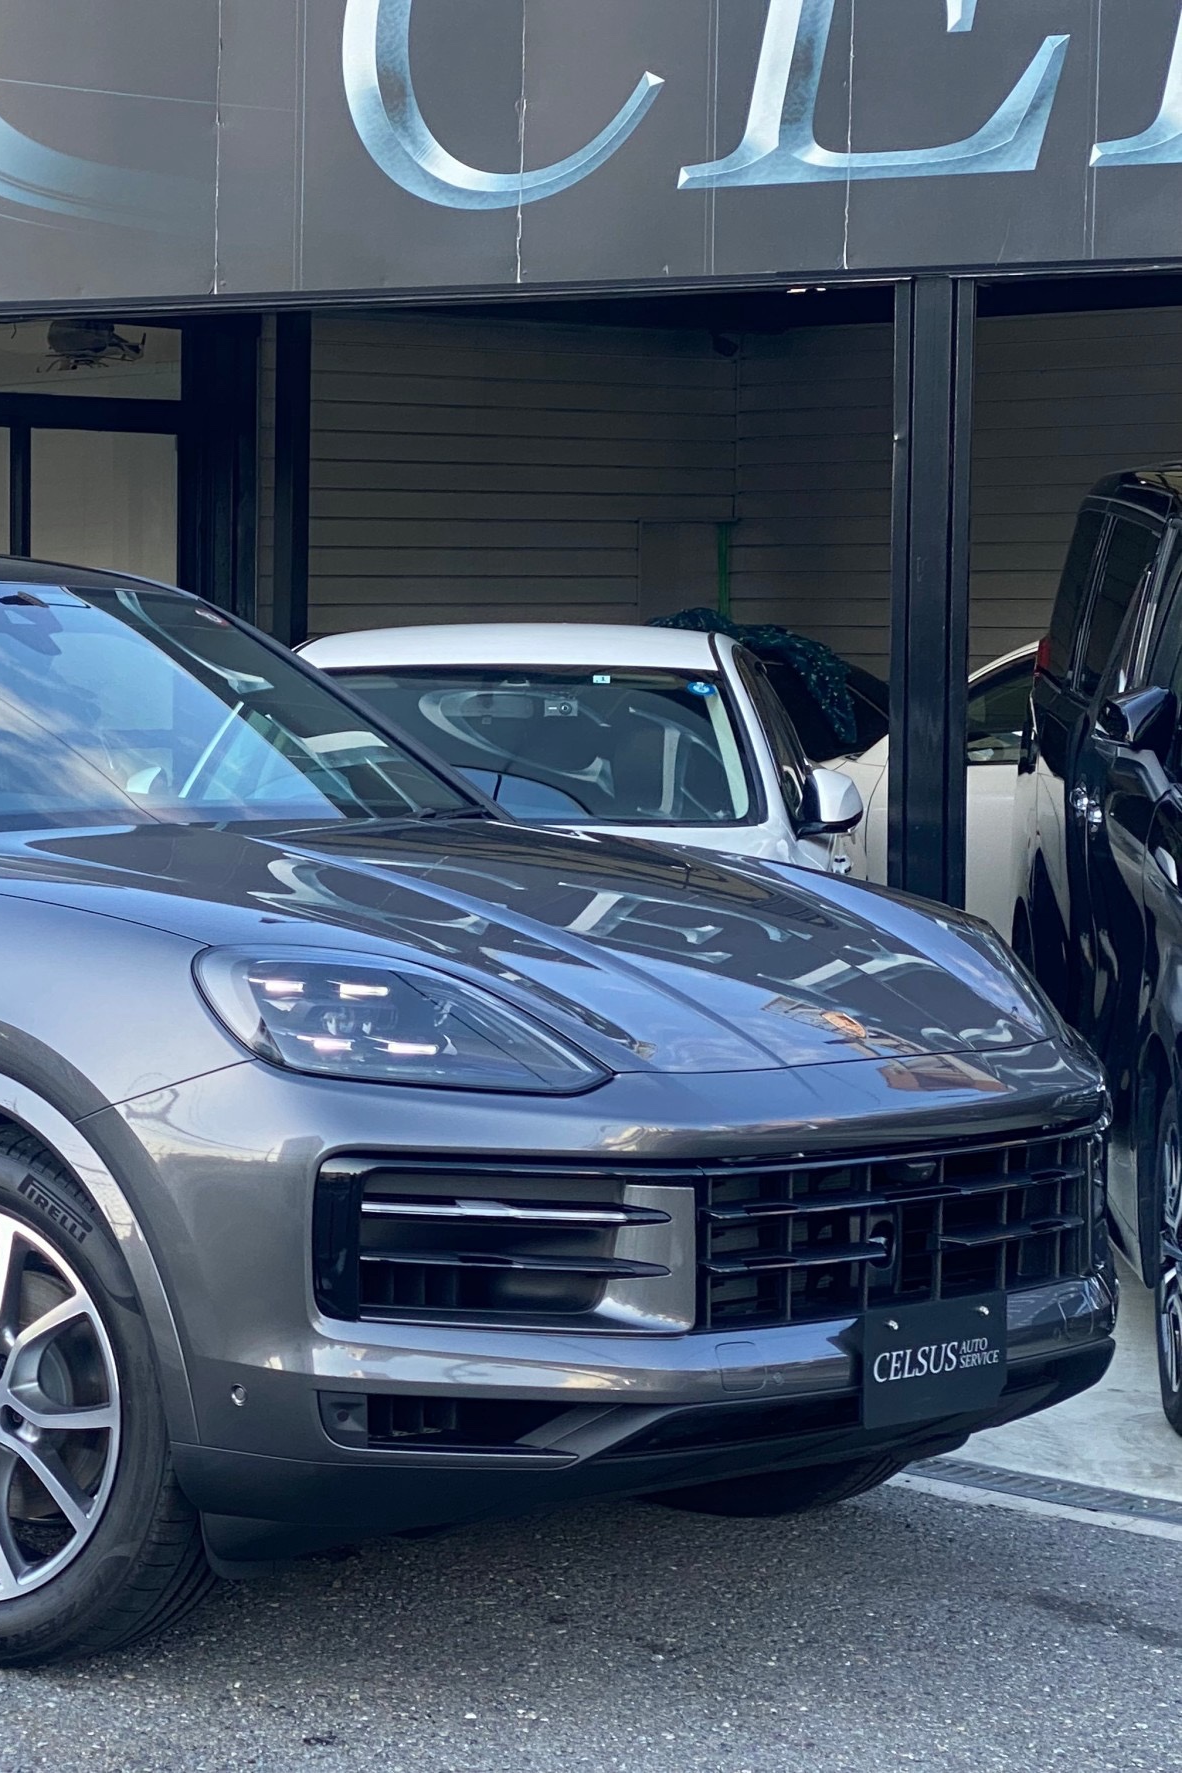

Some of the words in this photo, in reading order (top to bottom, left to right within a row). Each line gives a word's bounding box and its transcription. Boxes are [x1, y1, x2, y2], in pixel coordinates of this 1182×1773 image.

[17, 1173, 94, 1243] PIRELLI
[873, 1341, 958, 1382] CELSUS
[959, 1337, 987, 1354] AUTO
[959, 1350, 999, 1368] SERVICE
